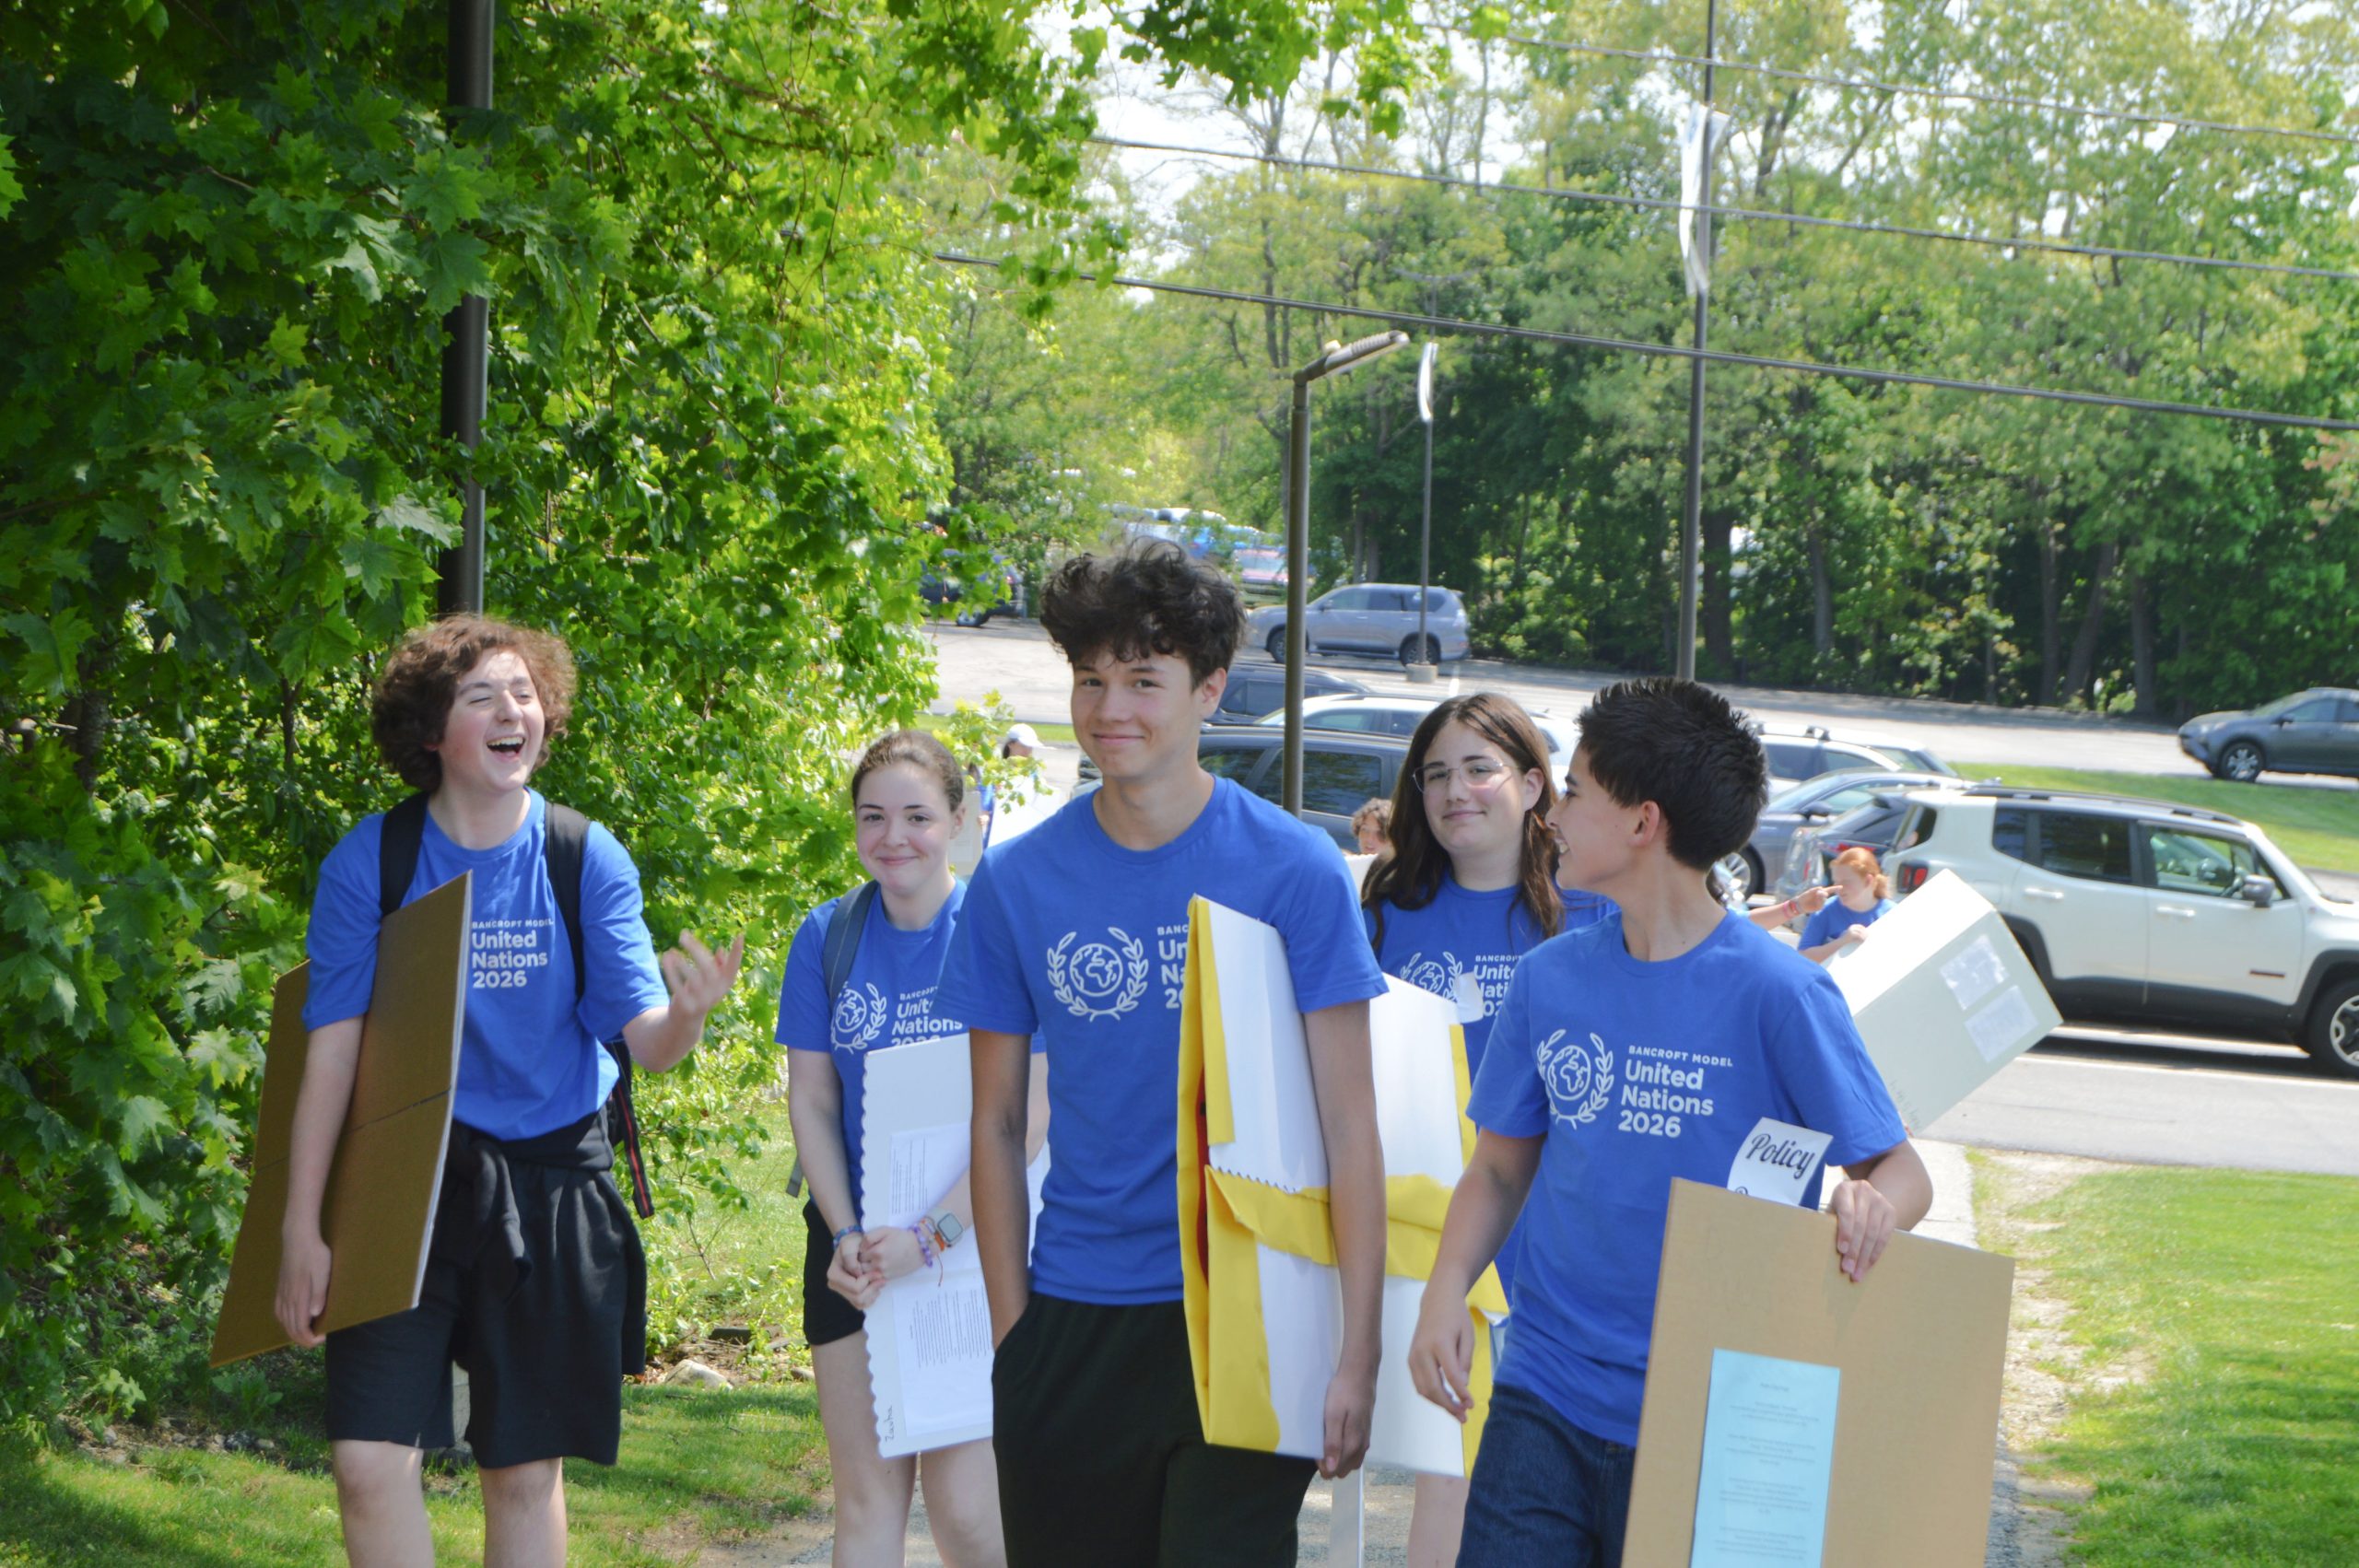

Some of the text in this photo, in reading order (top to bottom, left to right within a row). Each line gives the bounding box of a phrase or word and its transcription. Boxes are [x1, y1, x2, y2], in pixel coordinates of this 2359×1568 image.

[472, 919, 522, 930] BANCROFT
[1156, 924, 1188, 936] BANC
[471, 930, 537, 950] United
[471, 951, 548, 968] Nations
[473, 970, 527, 989] 2026
[1473, 964, 1514, 981] Unit
[897, 998, 933, 1019] Unit
[1628, 1045, 1733, 1067] BANCROFT MODEL
[1625, 1059, 1704, 1091] United
[1621, 1083, 1714, 1117] Nations
[1617, 1109, 1682, 1139] 2026
[1745, 1133, 1815, 1180] Policy
